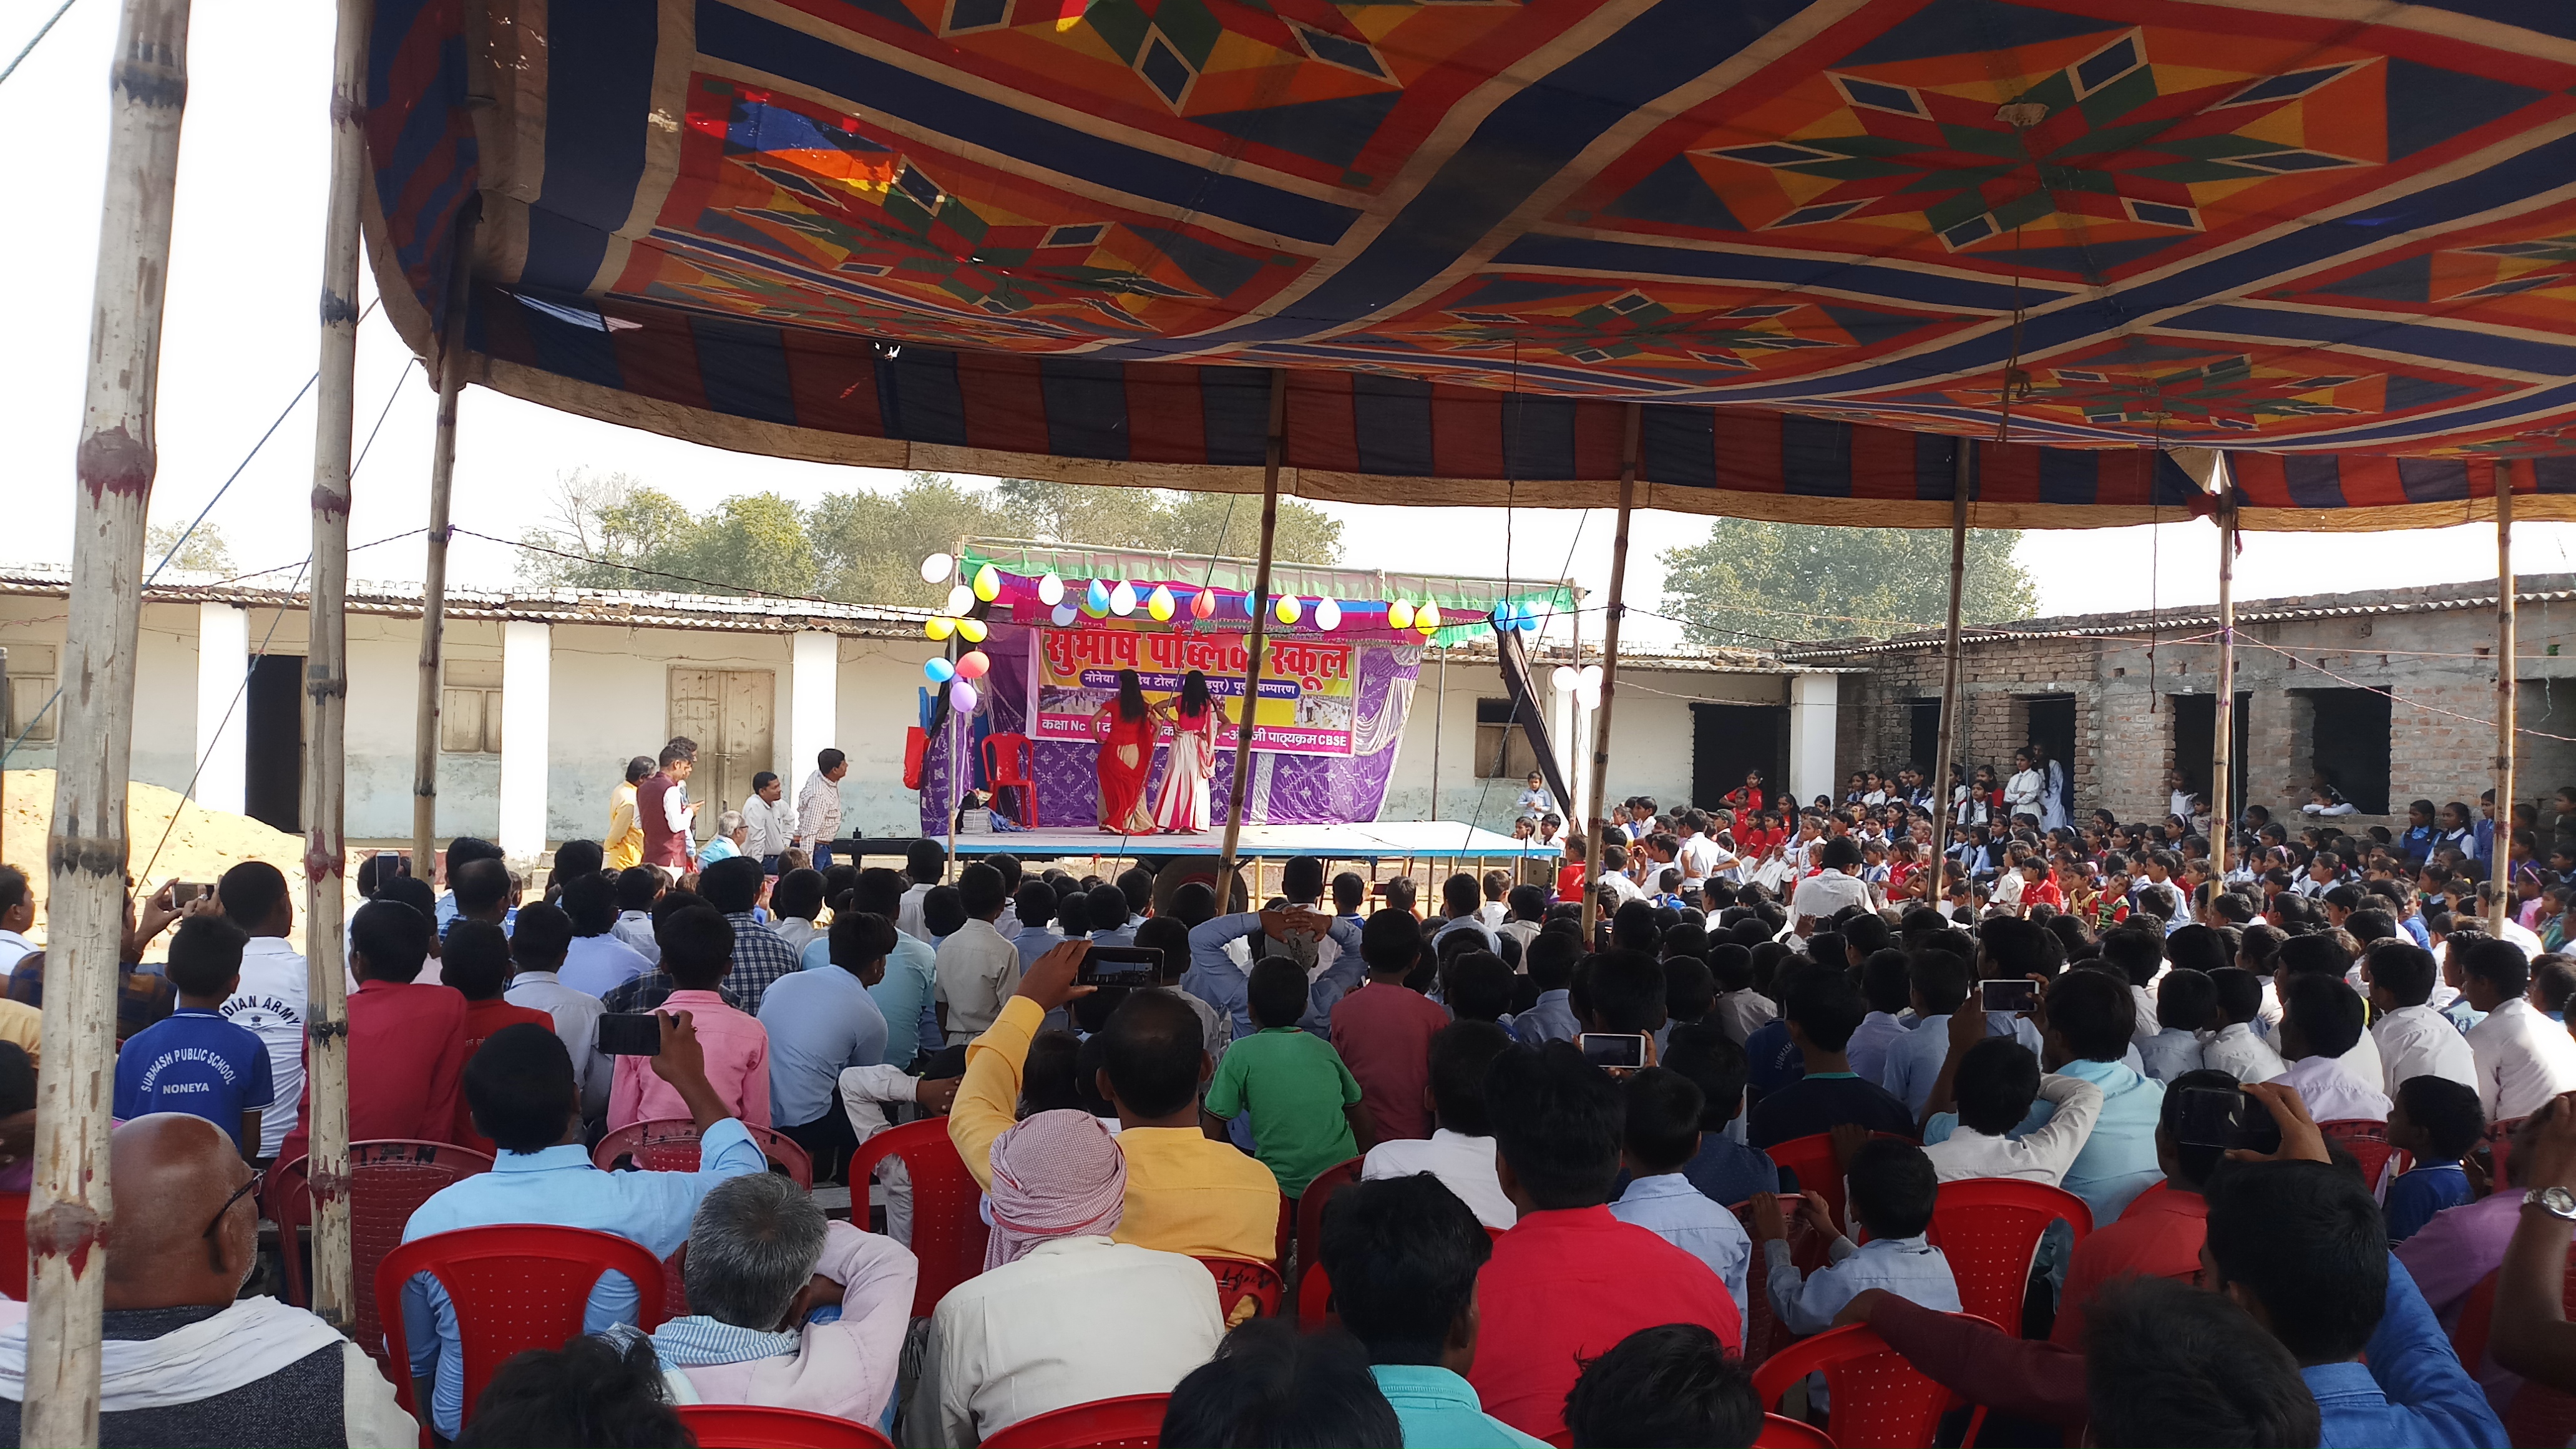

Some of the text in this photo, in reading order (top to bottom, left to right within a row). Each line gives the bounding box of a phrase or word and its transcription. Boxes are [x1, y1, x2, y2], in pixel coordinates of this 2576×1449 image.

[1044, 630, 1141, 677] सुभाष
[1269, 640, 1352, 692] स्कूल
[1042, 719, 1068, 730] कक्षा
[1318, 734, 1347, 746] CBSE
[221, 995, 301, 1025] DIAN ARMY
[140, 1048, 237, 1093] SUBHASH PUBLIC SCHOOL
[162, 1082, 210, 1095] NONEYA
